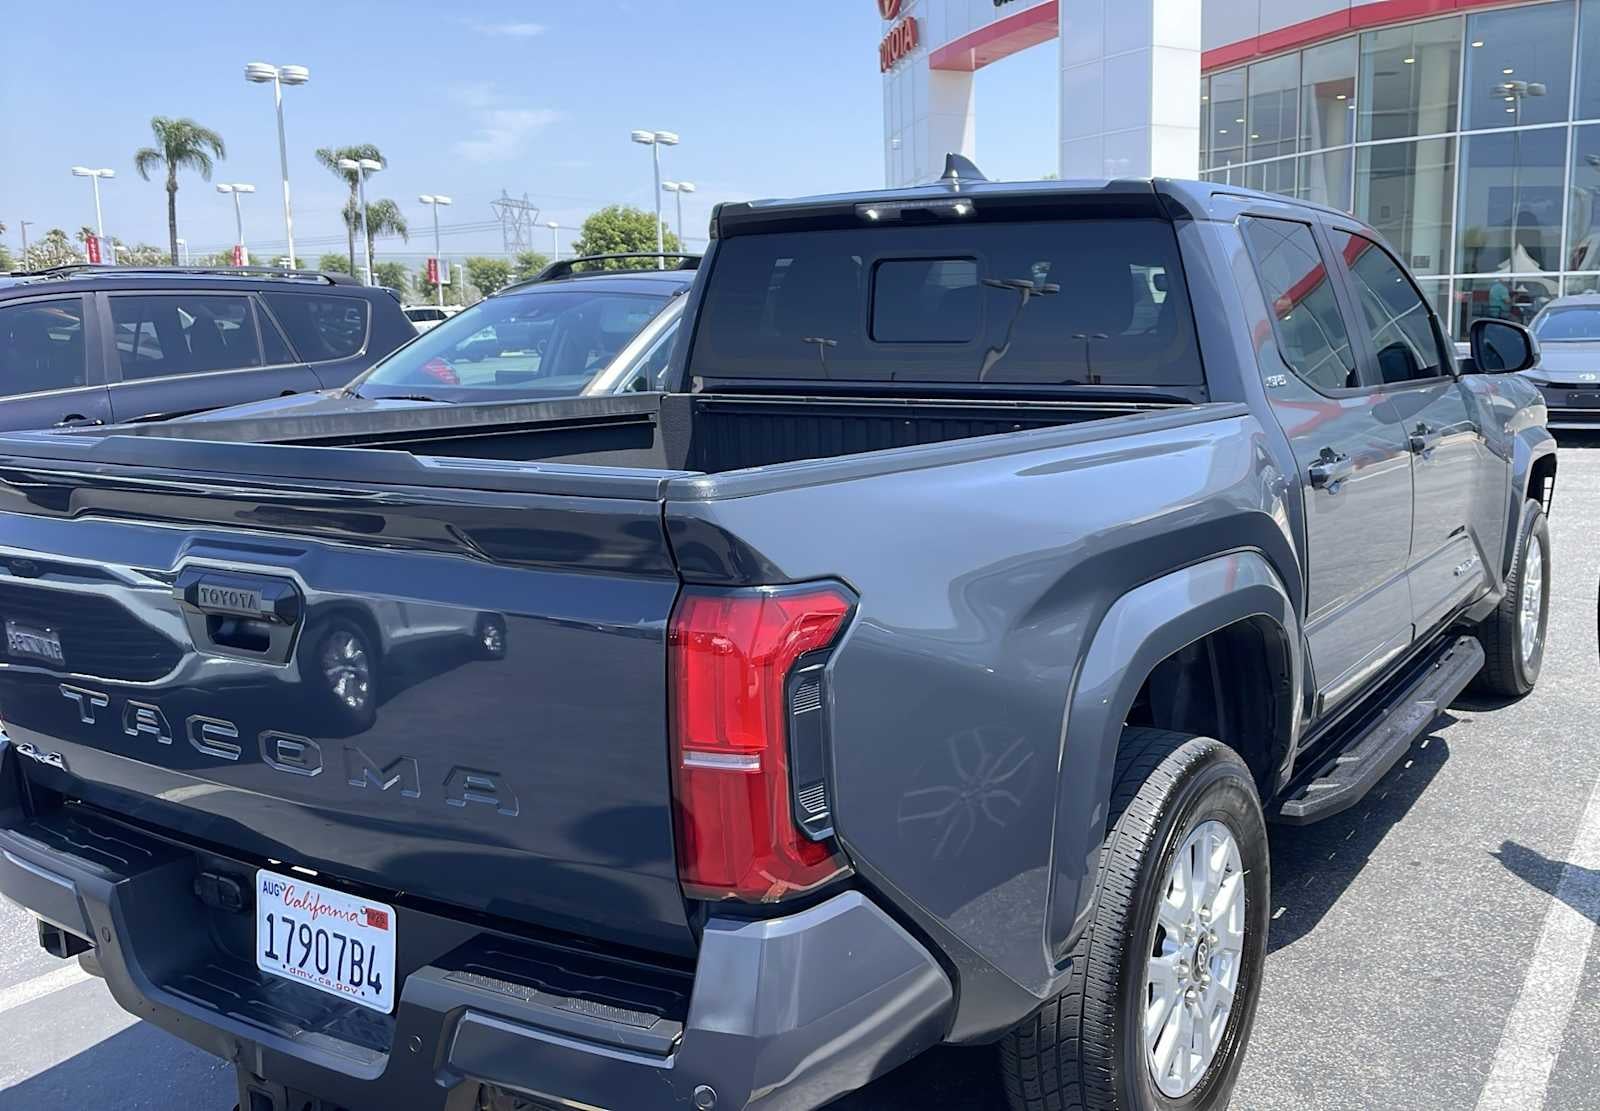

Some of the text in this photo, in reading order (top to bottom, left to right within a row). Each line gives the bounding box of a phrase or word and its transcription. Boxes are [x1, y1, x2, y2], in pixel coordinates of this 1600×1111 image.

[200, 587, 258, 611] TOYOTA
[58, 683, 520, 817] TACOMA
[262, 880, 280, 897] AUG
[284, 884, 369, 928] California
[264, 912, 383, 996] 17907B4
[289, 967, 359, 995] dmv.ca.gov
